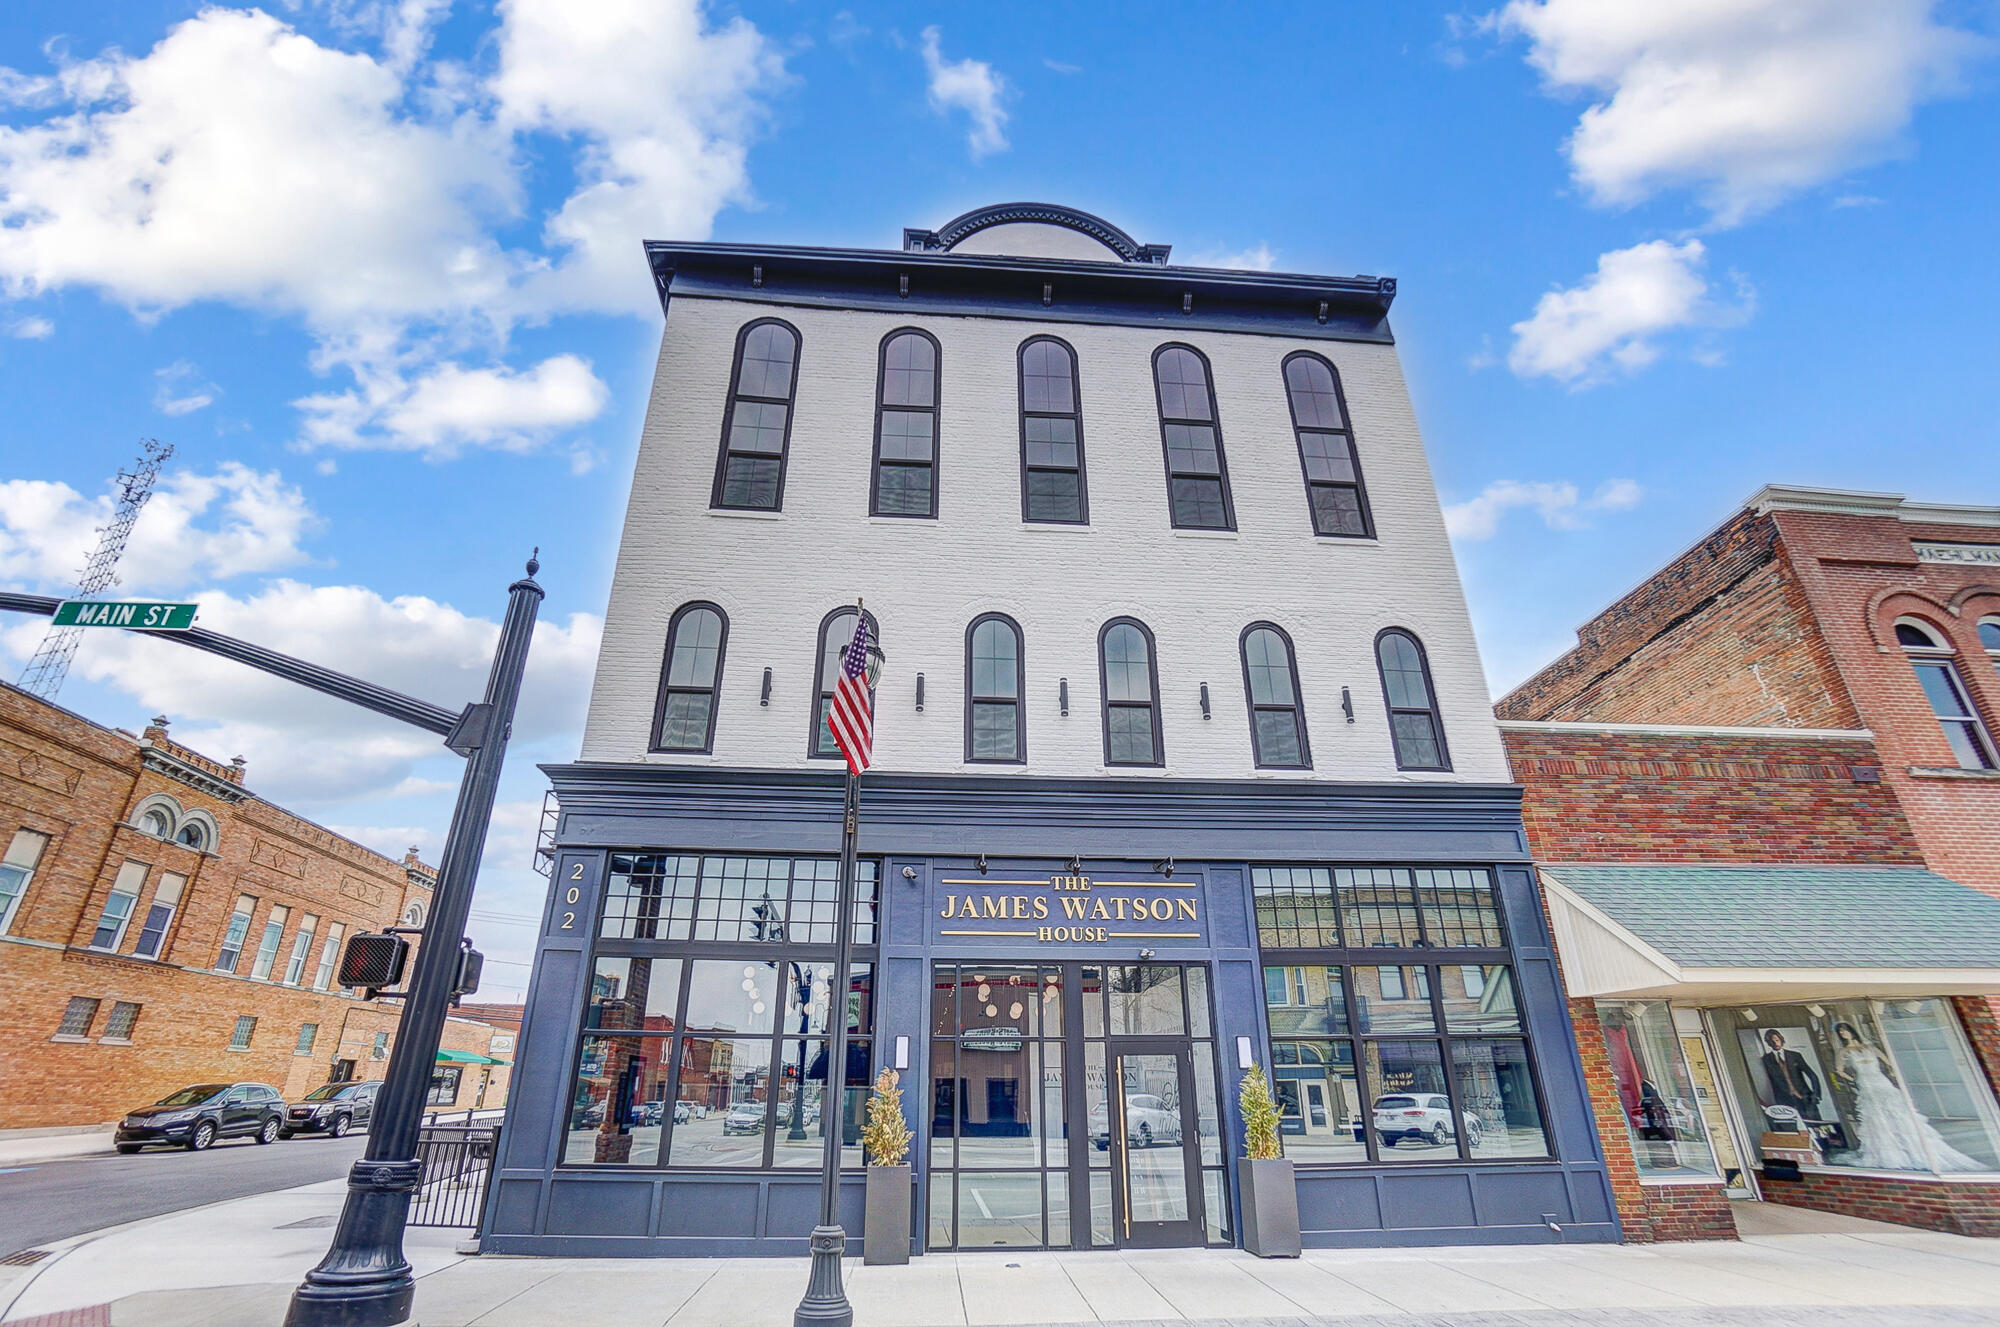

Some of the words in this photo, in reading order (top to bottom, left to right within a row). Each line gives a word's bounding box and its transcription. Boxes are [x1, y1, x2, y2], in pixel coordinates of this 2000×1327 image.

[75, 604, 137, 625] MAIN
[143, 605, 176, 626] ST
[1051, 876, 1092, 891] THE
[561, 863, 584, 929] 202
[941, 895, 1049, 920] JAMES
[1059, 897, 1198, 921] WATSON
[1038, 927, 1108, 942] HOUSE
